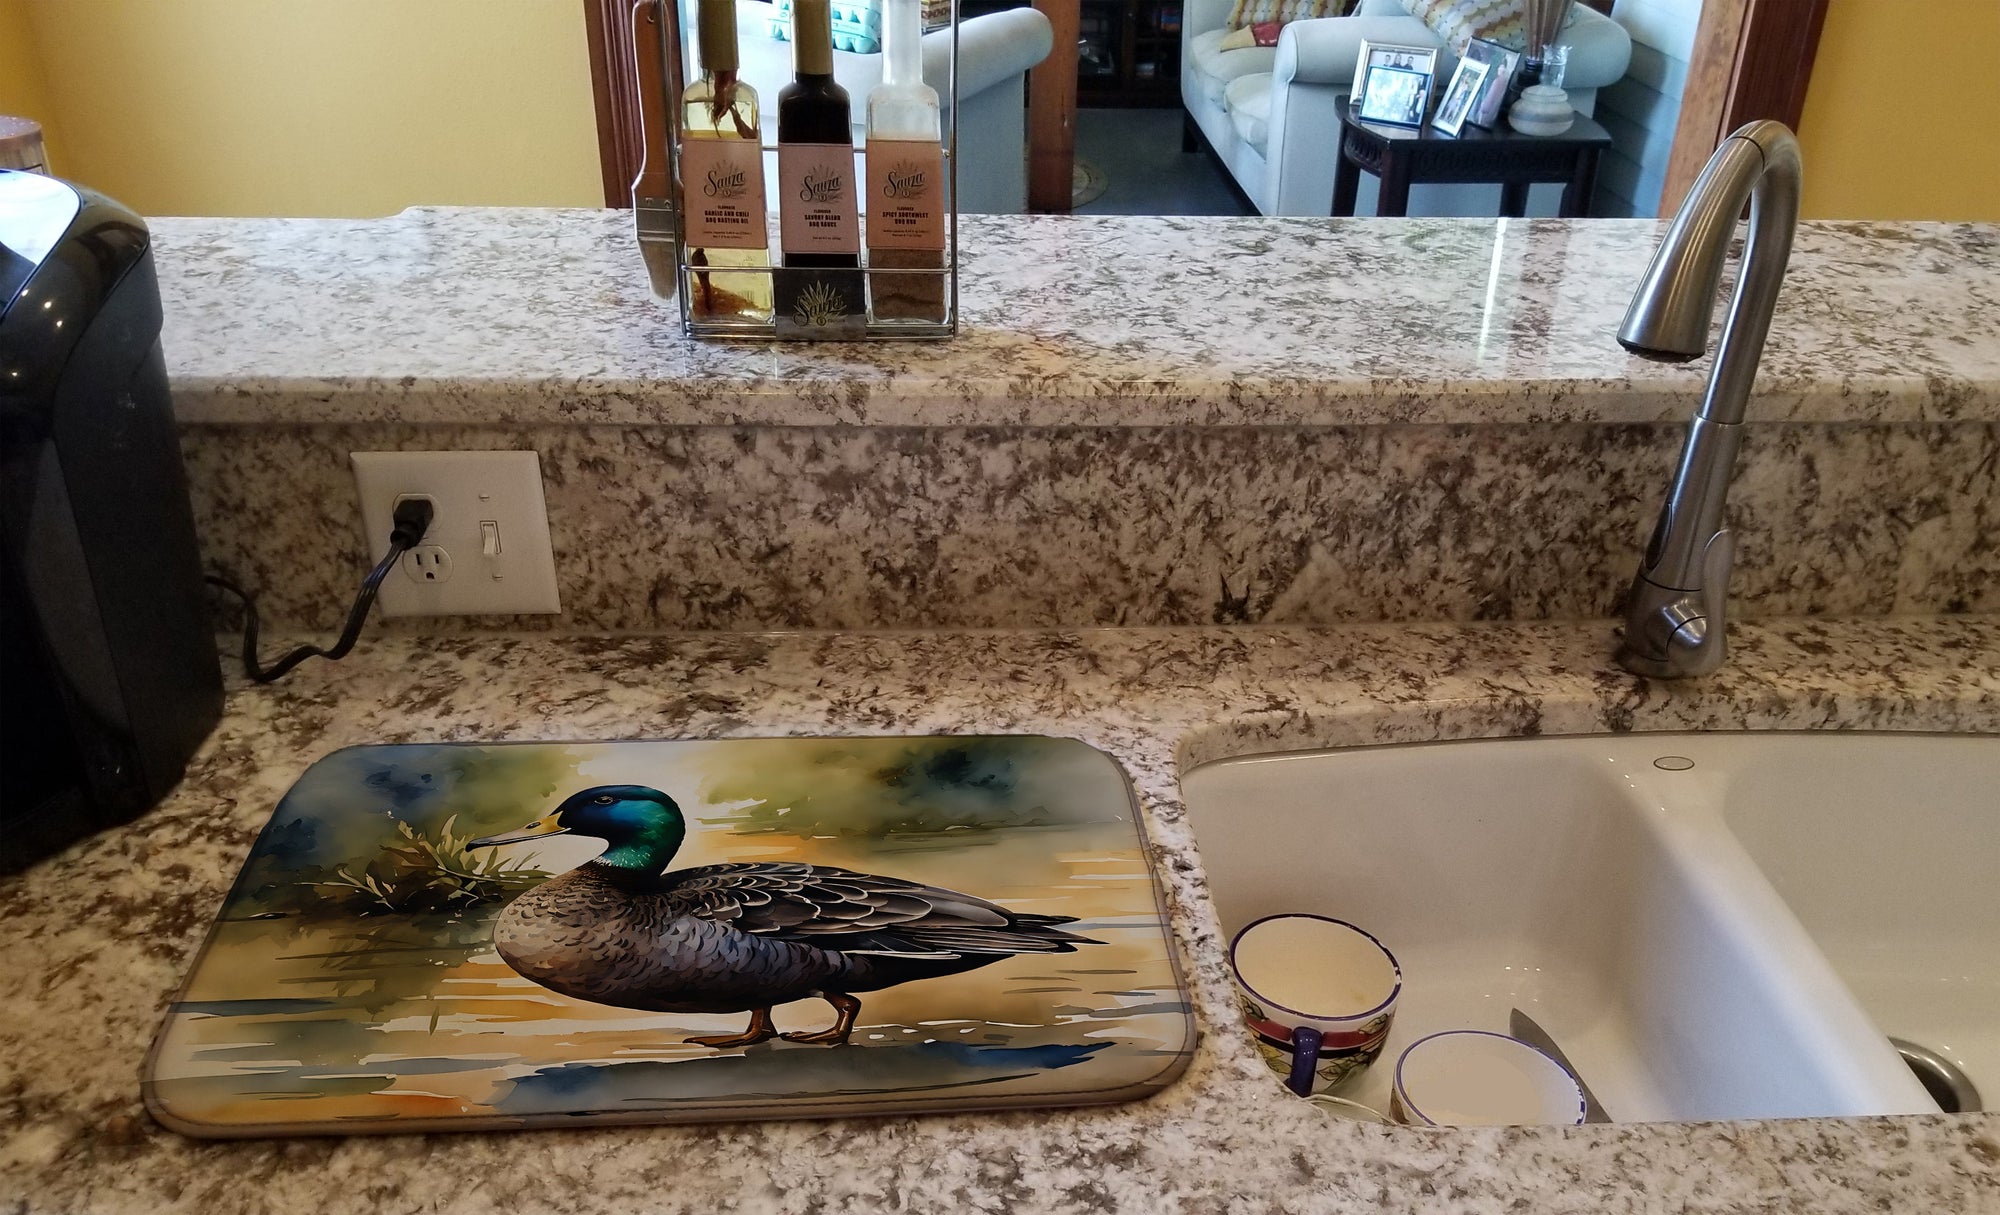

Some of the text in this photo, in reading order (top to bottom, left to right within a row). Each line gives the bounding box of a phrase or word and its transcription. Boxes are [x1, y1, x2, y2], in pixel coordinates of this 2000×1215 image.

[704, 170, 745, 197] Sauza
[800, 175, 842, 202] Sauza
[883, 171, 926, 198] Sauza
[793, 295, 844, 327] Sauza
